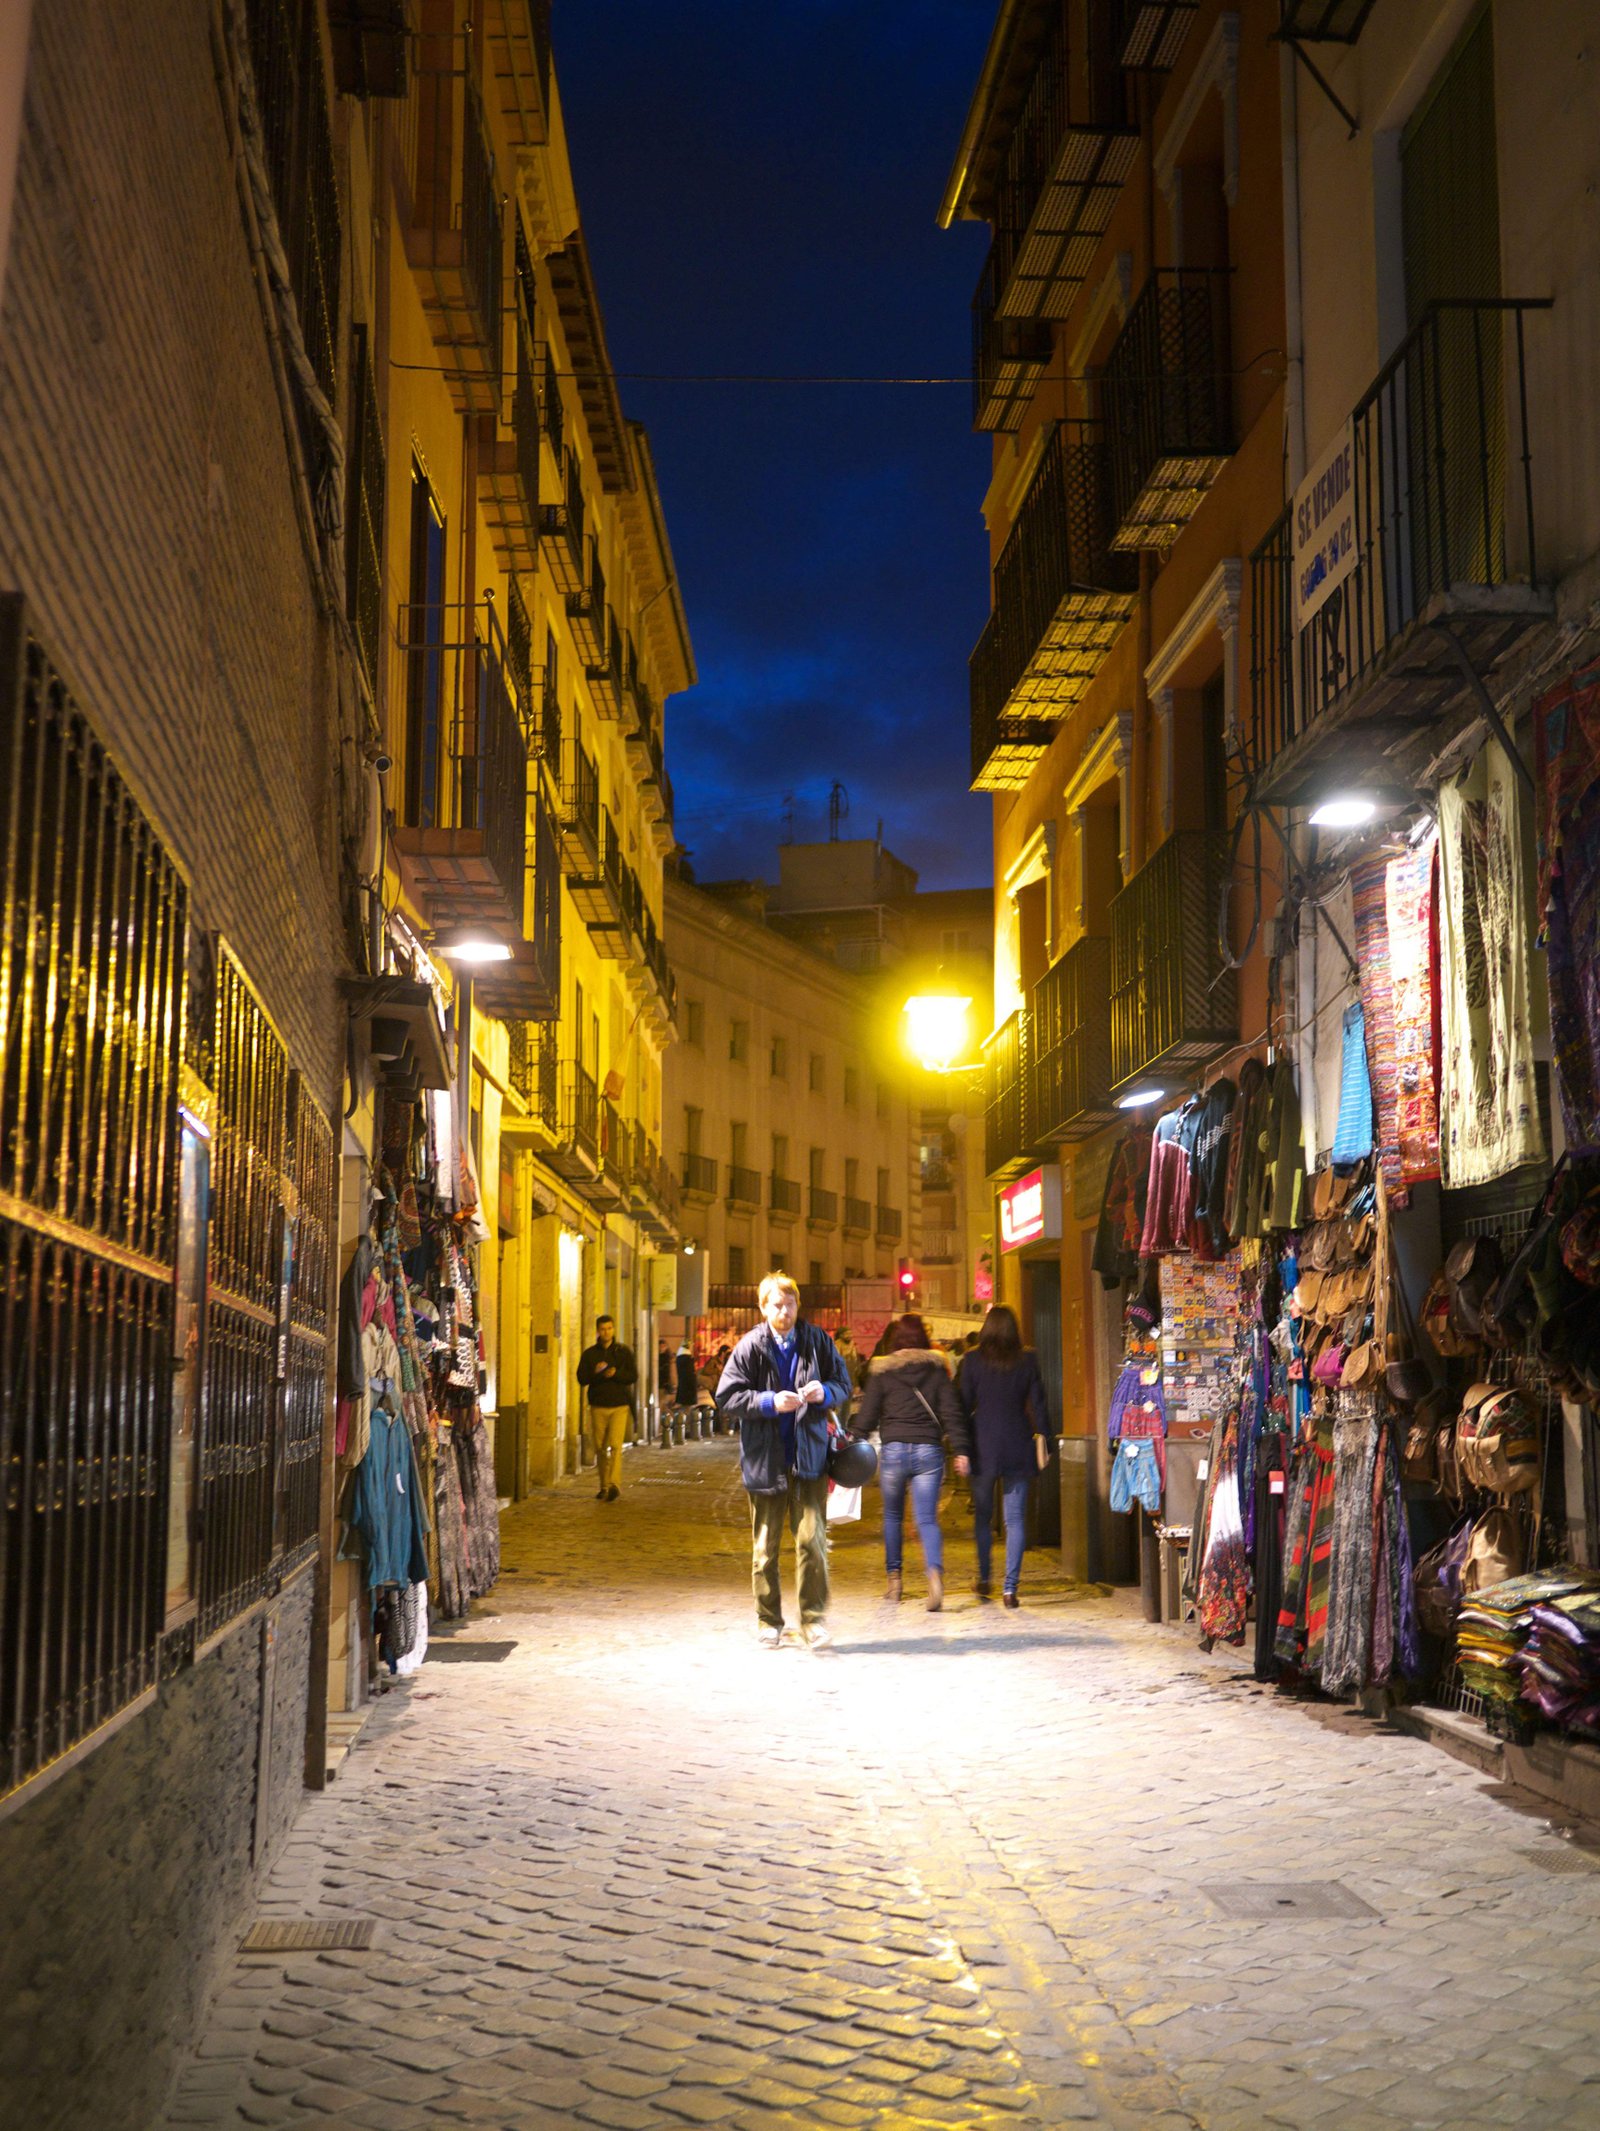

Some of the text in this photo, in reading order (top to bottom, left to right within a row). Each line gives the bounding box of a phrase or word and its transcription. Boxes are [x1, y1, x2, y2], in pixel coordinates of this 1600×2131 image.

[1298, 443, 1350, 549] SE VENDE
[1341, 515, 1352, 557] 82
